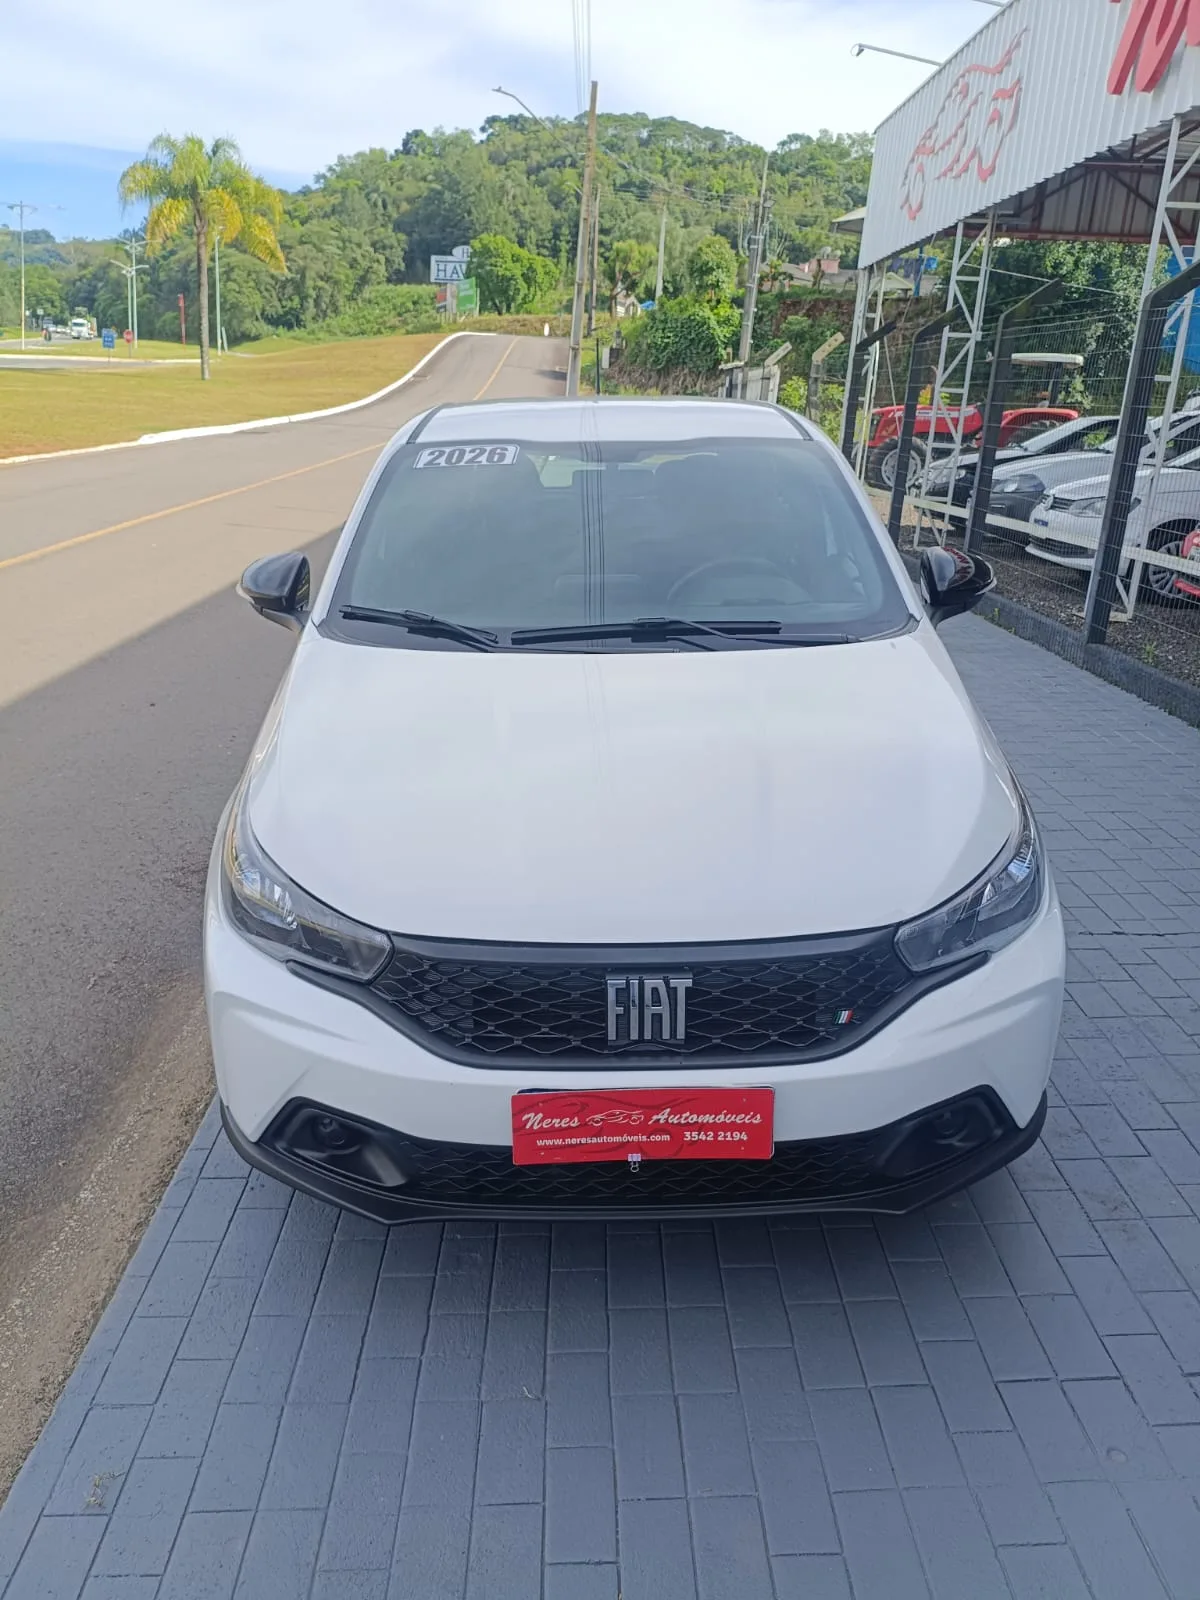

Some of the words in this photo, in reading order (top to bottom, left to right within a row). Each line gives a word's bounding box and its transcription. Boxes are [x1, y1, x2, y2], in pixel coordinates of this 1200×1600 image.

[423, 447, 509, 466] 2026
[606, 979, 693, 1041] FIAT
[521, 1112, 580, 1130] Neres
[647, 1107, 762, 1125] Automóveis
[683, 1131, 714, 1141] 3542
[717, 1131, 748, 1141] 2194
